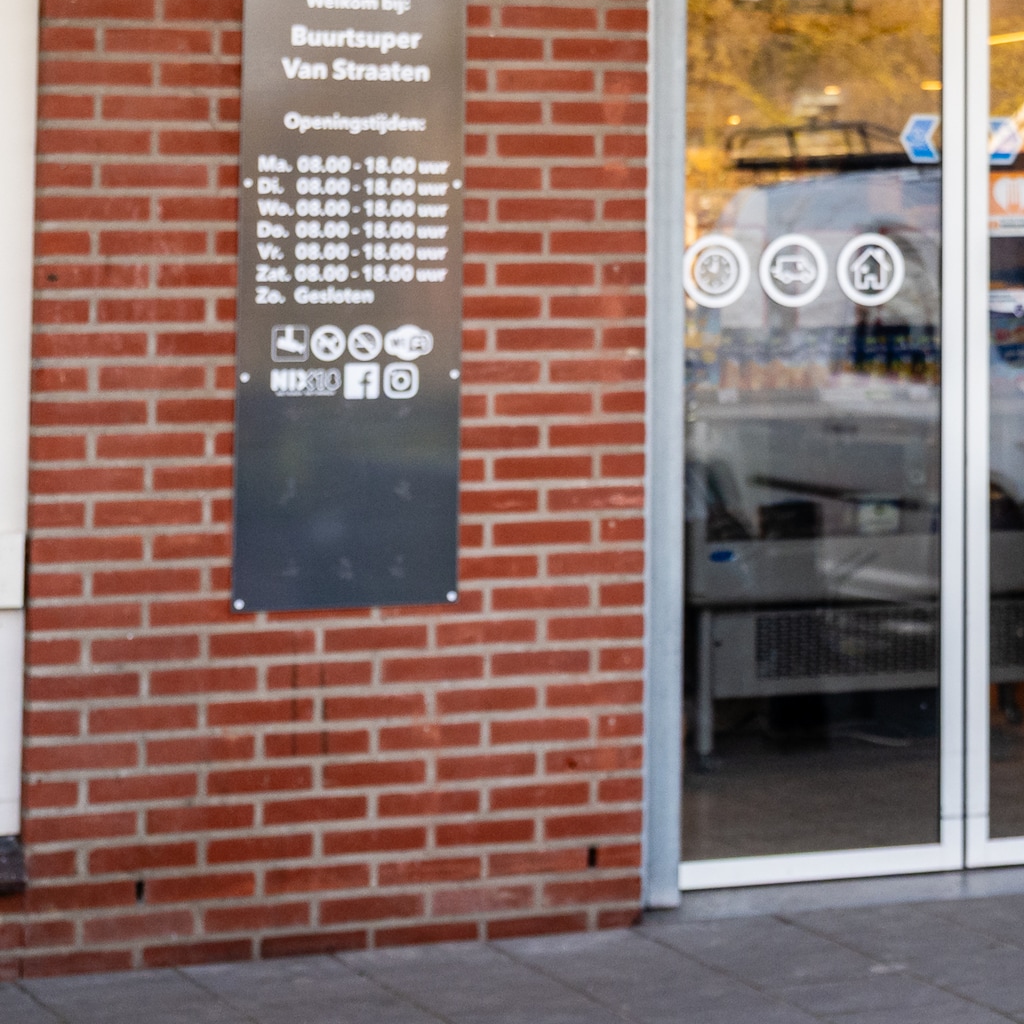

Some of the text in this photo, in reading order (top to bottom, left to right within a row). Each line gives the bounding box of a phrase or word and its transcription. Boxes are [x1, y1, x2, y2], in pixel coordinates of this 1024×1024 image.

[290, 23, 423, 54] Buurtsuper
[280, 56, 431, 82] Van Straaten
[283, 111, 427, 135] Openingstijden:
[258, 155, 292, 173] Ma.
[297, 156, 351, 174] 08.00
[364, 157, 416, 175] 18.00
[418, 161, 450, 174] uur
[257, 177, 285, 195] Di.
[296, 177, 350, 195] 08.00
[364, 178, 416, 196] 18.00
[417, 183, 449, 196] uur
[257, 199, 294, 217] Wo.
[296, 199, 350, 217] 08.00
[364, 200, 415, 217] 18.00
[417, 204, 449, 217] uur
[256, 221, 289, 238] Do.
[295, 221, 349, 239] 08.00
[363, 221, 415, 239] 18.00
[417, 225, 449, 239] uur
[295, 242, 349, 261] 08.00
[363, 243, 415, 260] 18.00
[416, 247, 449, 260] uur
[295, 264, 349, 282] 08.00
[362, 265, 414, 282] 18.00
[416, 268, 448, 282] uur
[255, 285, 375, 304] Zo. Gesloten
